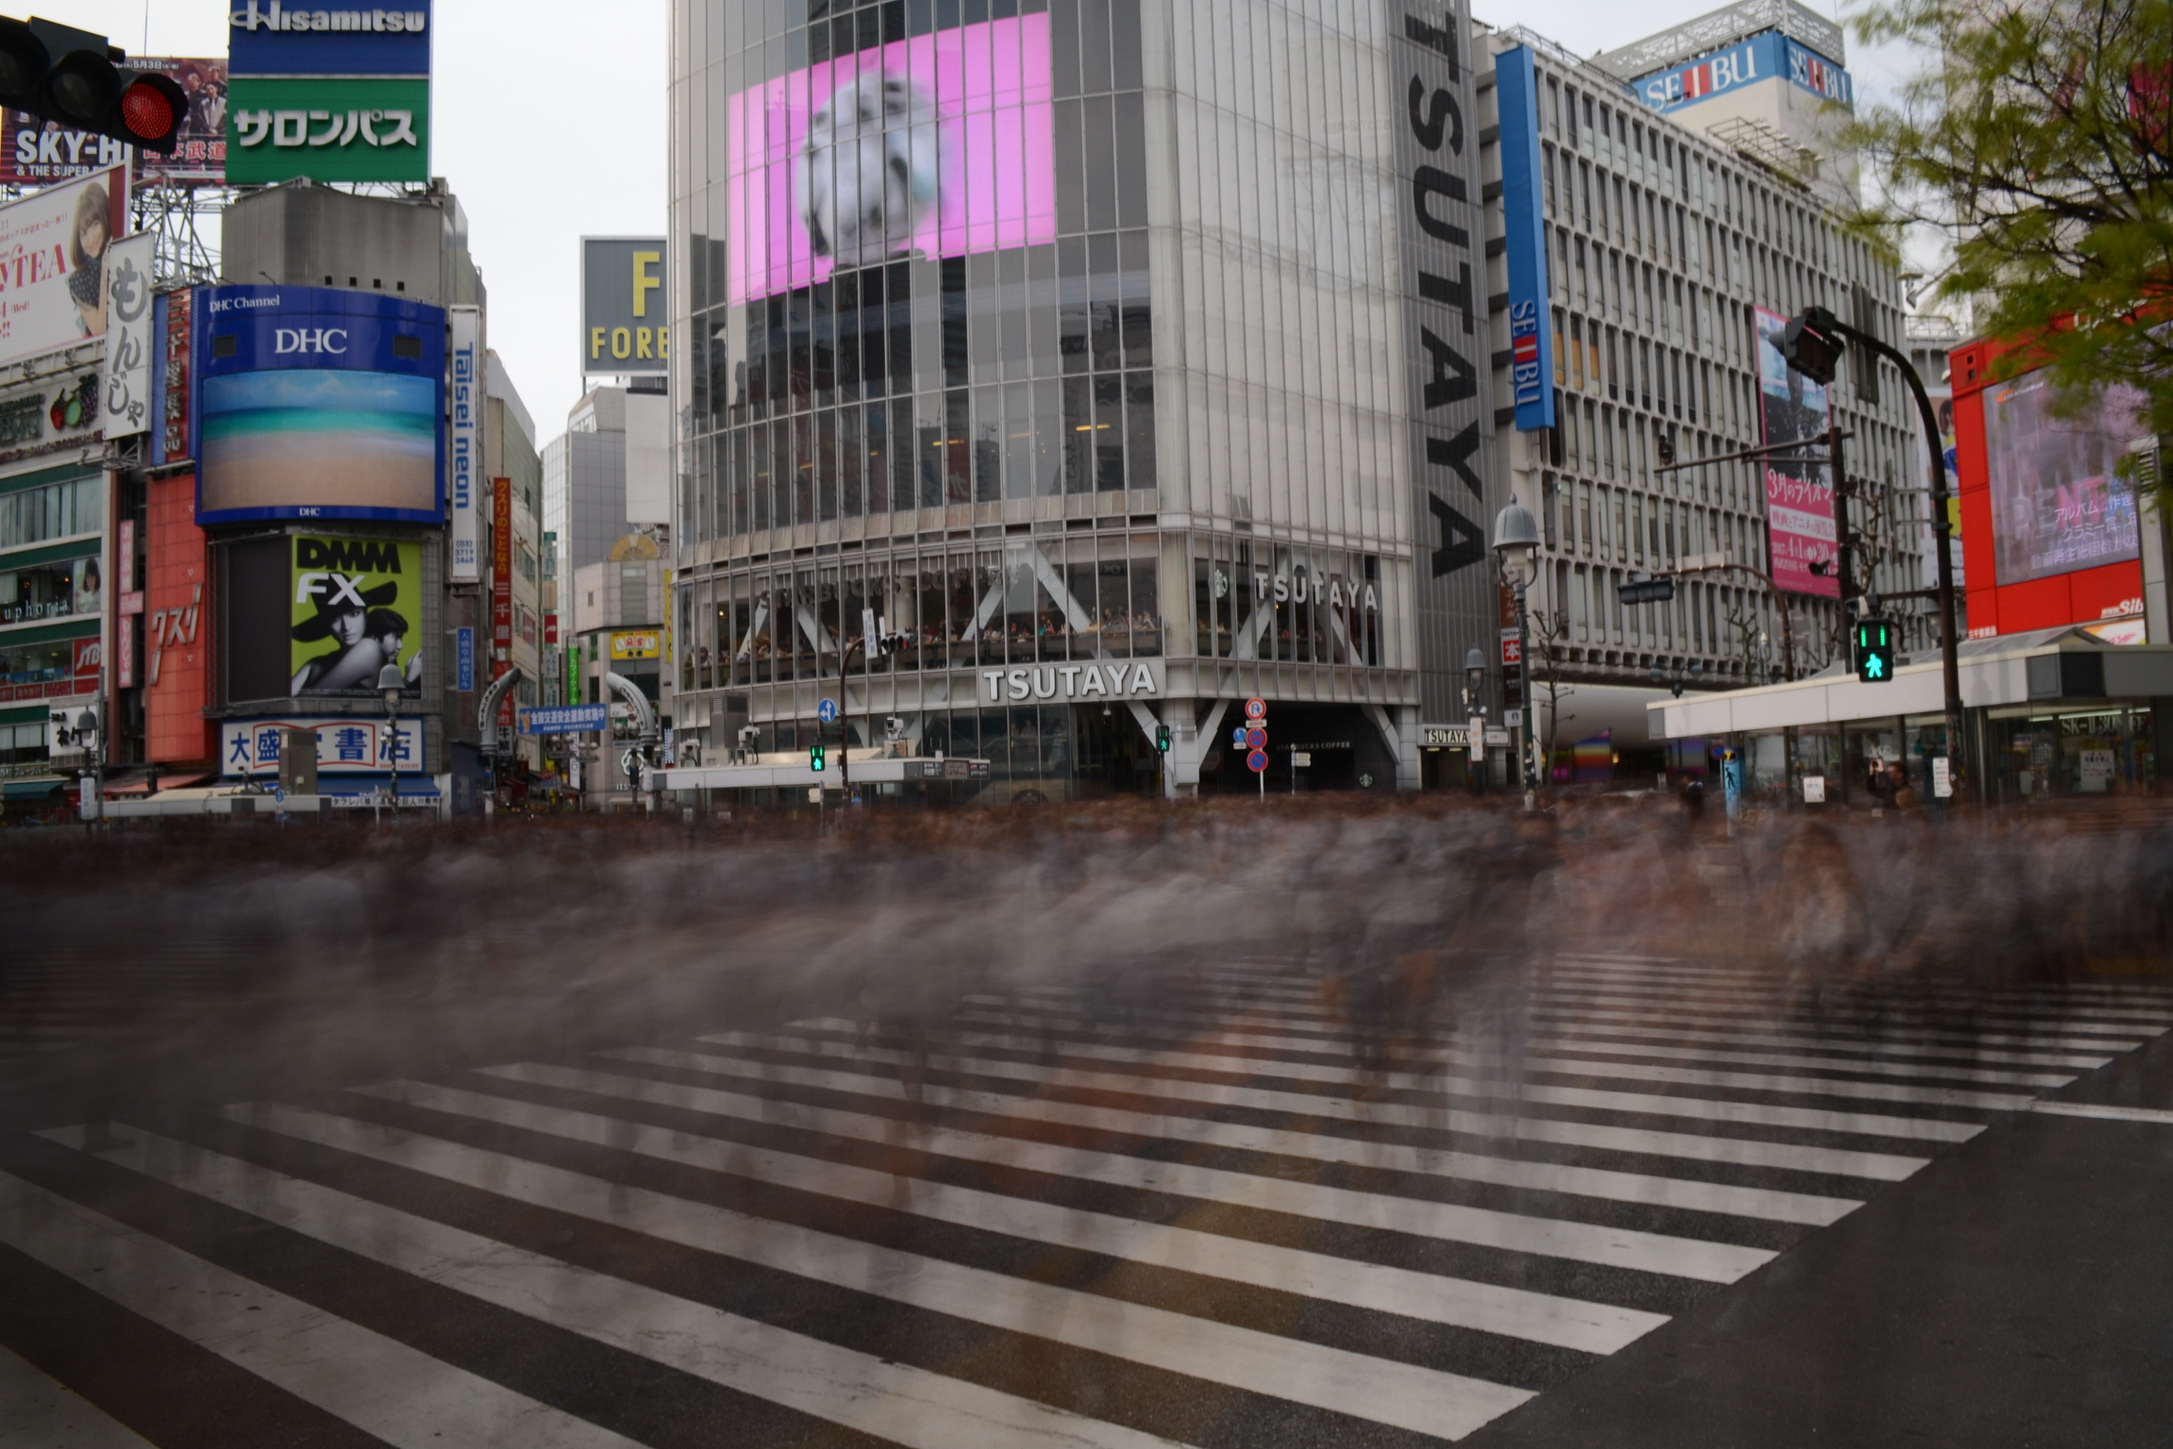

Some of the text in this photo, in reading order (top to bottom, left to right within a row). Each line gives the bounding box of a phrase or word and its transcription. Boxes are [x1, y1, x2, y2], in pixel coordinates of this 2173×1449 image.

[228, 0, 425, 32] Hisamitsu
[1646, 45, 1756, 113] SEIBU
[1789, 47, 1848, 103] SEIBU
[233, 109, 417, 147] サロンパス
[29, 164, 51, 177] THE
[53, 164, 89, 177] SUPER
[632, 251, 660, 318] F
[209, 294, 281, 313] DHC Channel
[274, 328, 348, 355] DHC
[1511, 299, 1540, 407] SEIBU
[454, 340, 475, 509] Taisei neon
[299, 507, 321, 517] DHC
[295, 537, 402, 575] DMM
[295, 572, 367, 607] FX
[1254, 572, 1378, 611] TSUTAYA
[76, 642, 101, 670] JTB
[1506, 642, 1521, 660] 本
[983, 662, 1157, 701] TSUTAYA
[229, 728, 412, 764] 大盛書店
[1320, 740, 1351, 750] COFFEE
[1425, 728, 1468, 743] TSUTAYA
